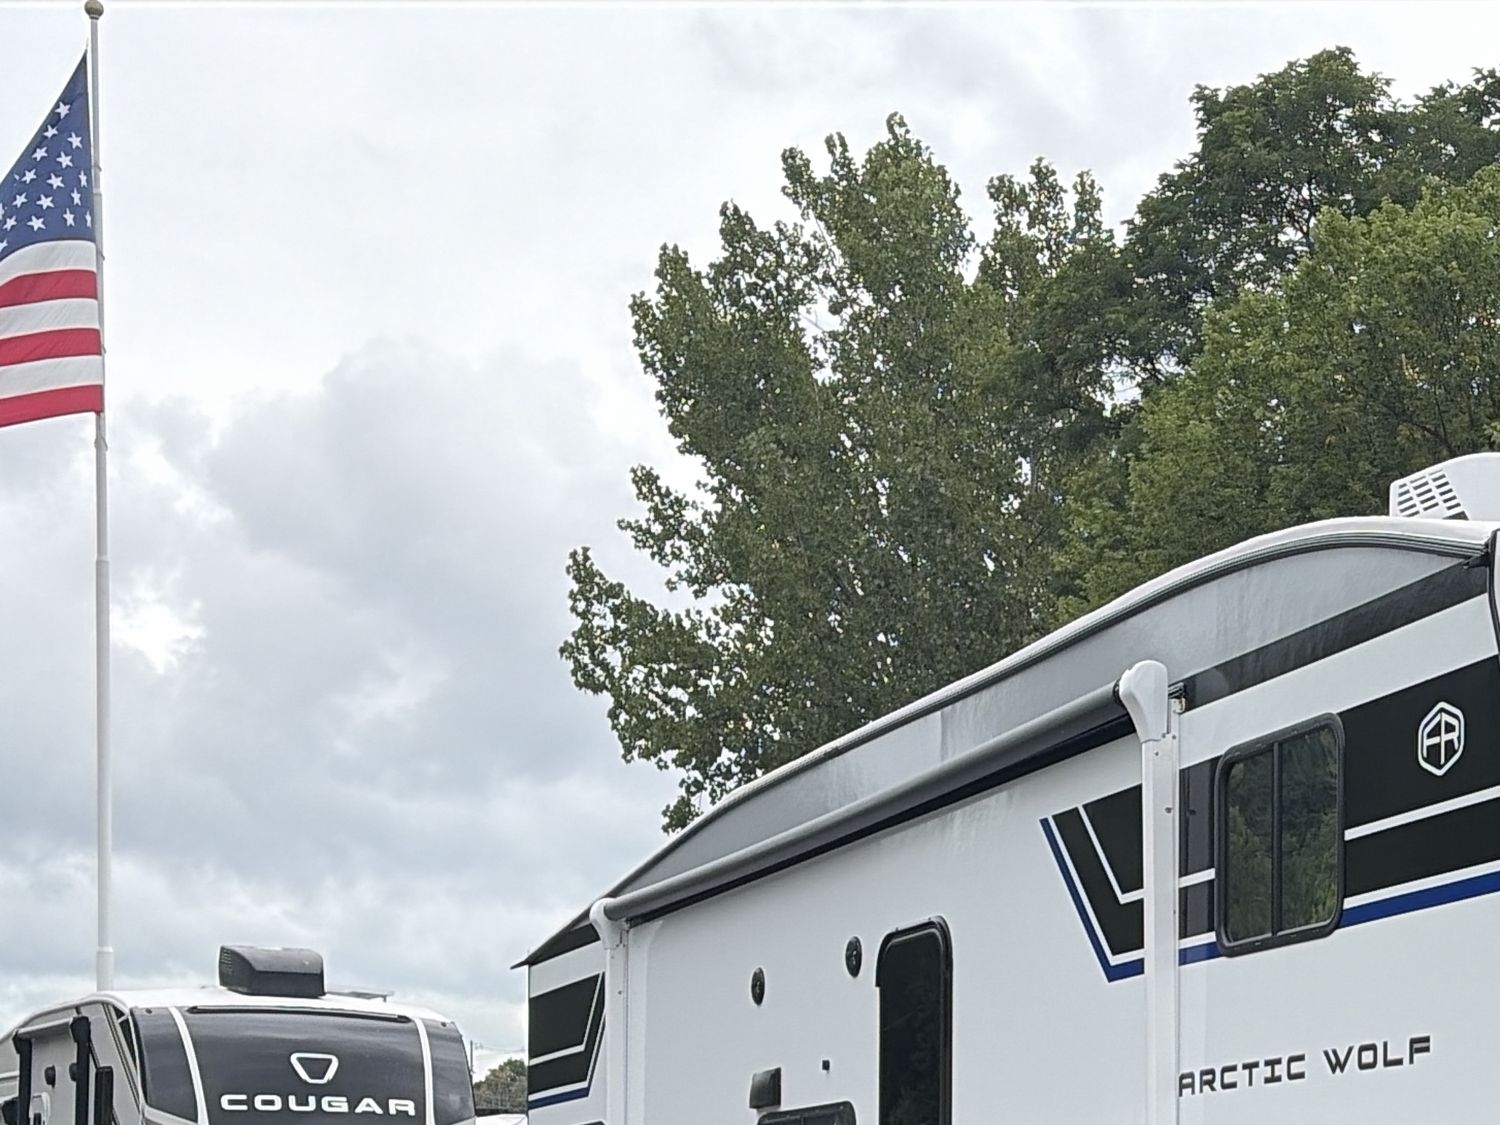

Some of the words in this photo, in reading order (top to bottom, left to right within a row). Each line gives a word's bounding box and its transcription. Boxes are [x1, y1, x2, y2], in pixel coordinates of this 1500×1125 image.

[1178, 1053, 1306, 1098] ARCTIC
[1322, 1035, 1431, 1075] WOLF
[220, 1094, 416, 1117] COUGAR
